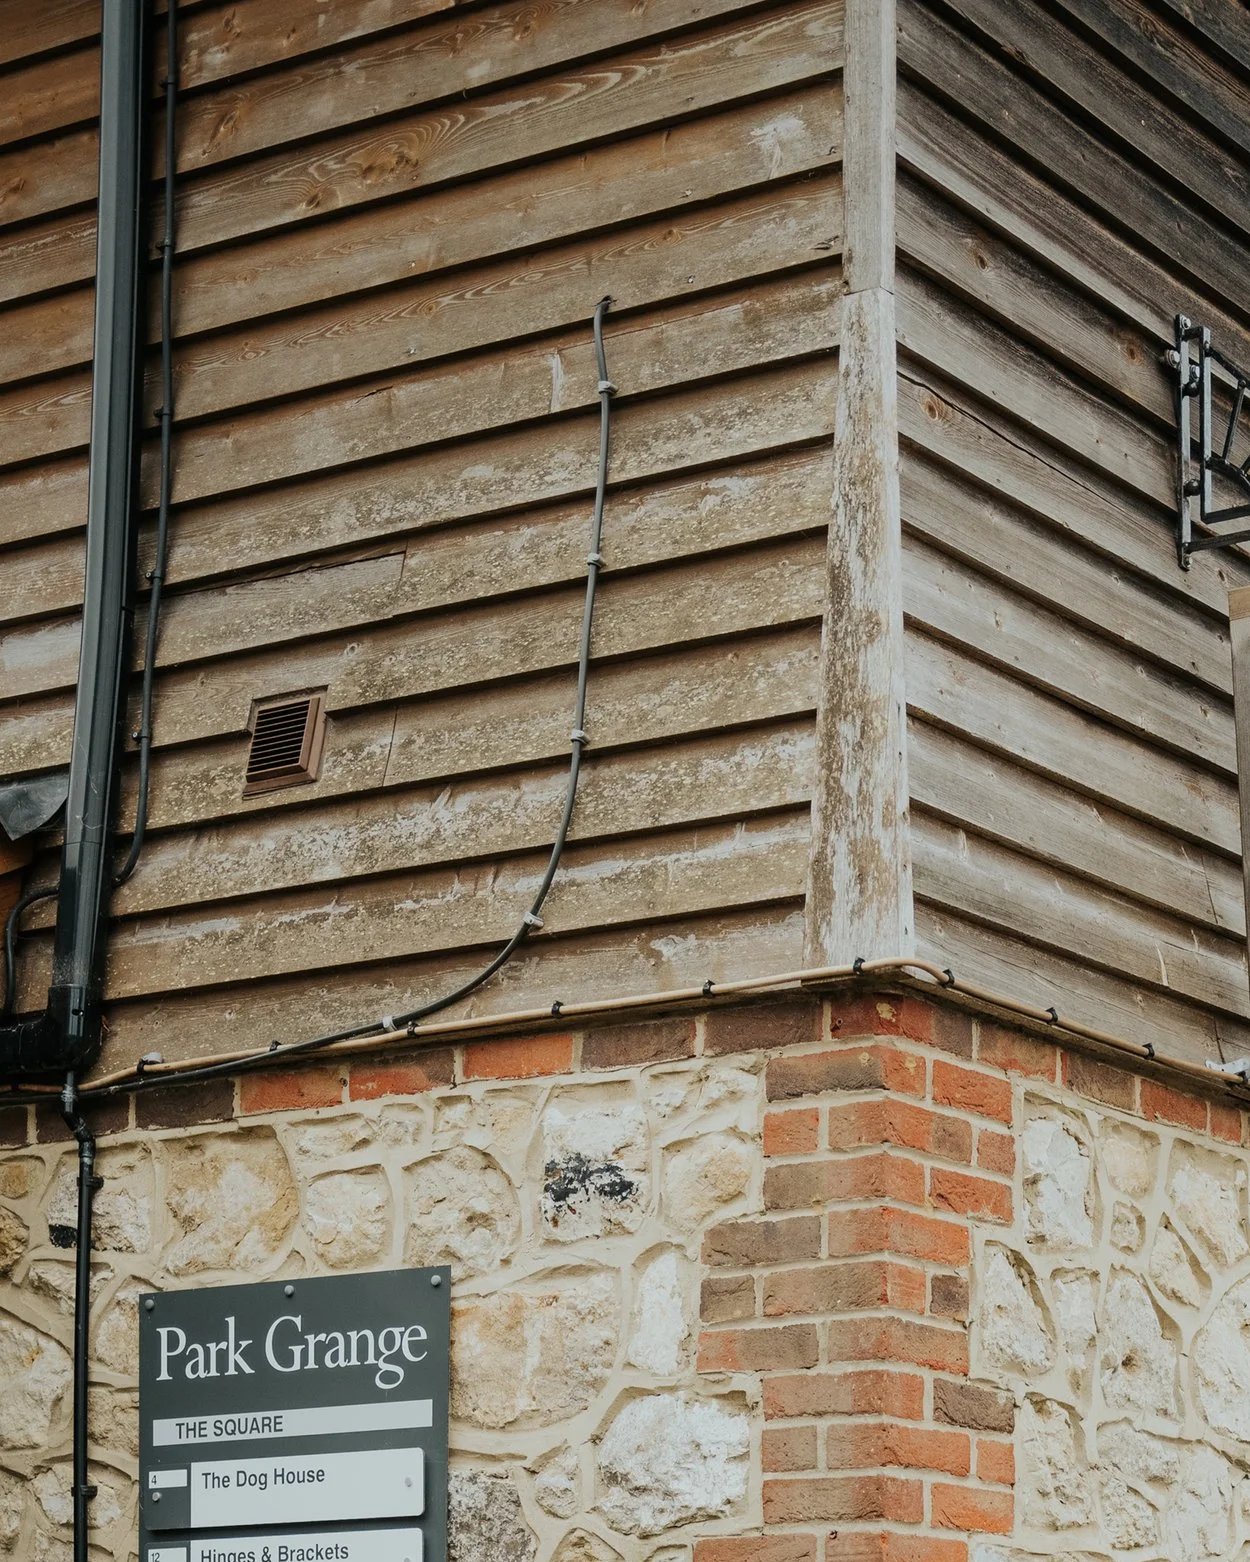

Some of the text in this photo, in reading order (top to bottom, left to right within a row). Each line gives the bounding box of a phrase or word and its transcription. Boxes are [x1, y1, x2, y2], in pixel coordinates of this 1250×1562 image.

[156, 1314, 428, 1389] Park Grange
[175, 1416, 283, 1439] THE SQUARE
[151, 1475, 157, 1485] 4
[202, 1466, 325, 1492] The Dog House
[151, 1552, 160, 1562] 12
[261, 1545, 272, 1562] &
[279, 1542, 349, 1562] Brackets
